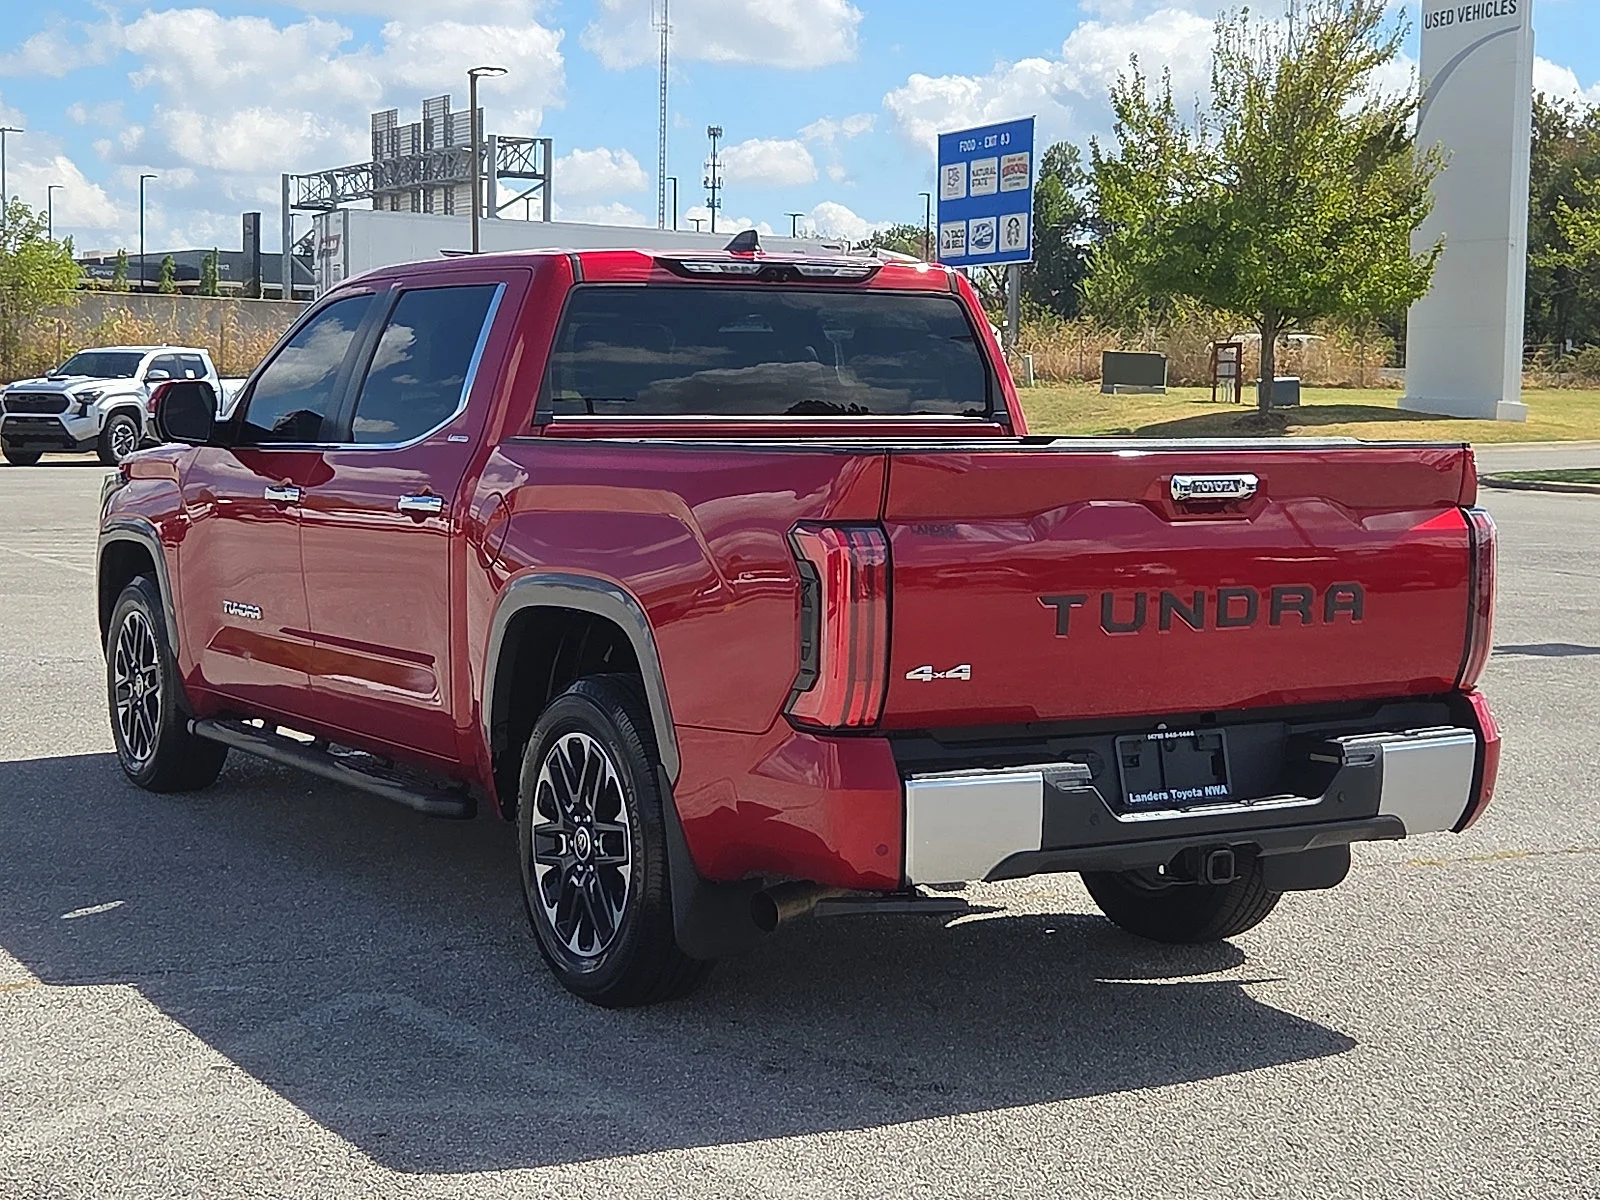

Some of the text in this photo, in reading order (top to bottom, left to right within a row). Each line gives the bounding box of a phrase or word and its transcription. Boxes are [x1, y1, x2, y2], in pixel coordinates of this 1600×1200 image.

[1424, 0, 1517, 29] USED VEHICLES
[959, 139, 976, 152] FOOD
[985, 135, 997, 148] EXIT
[972, 166, 996, 177] NATURAL
[972, 177, 988, 187] STATE
[951, 229, 965, 239] TACO
[951, 239, 965, 249] BELL
[1194, 480, 1236, 492] TOYOTA
[222, 599, 262, 620] TUNDRA
[1037, 580, 1366, 638] TUNDRA
[1128, 784, 1228, 803] Landers Toyota NWA
